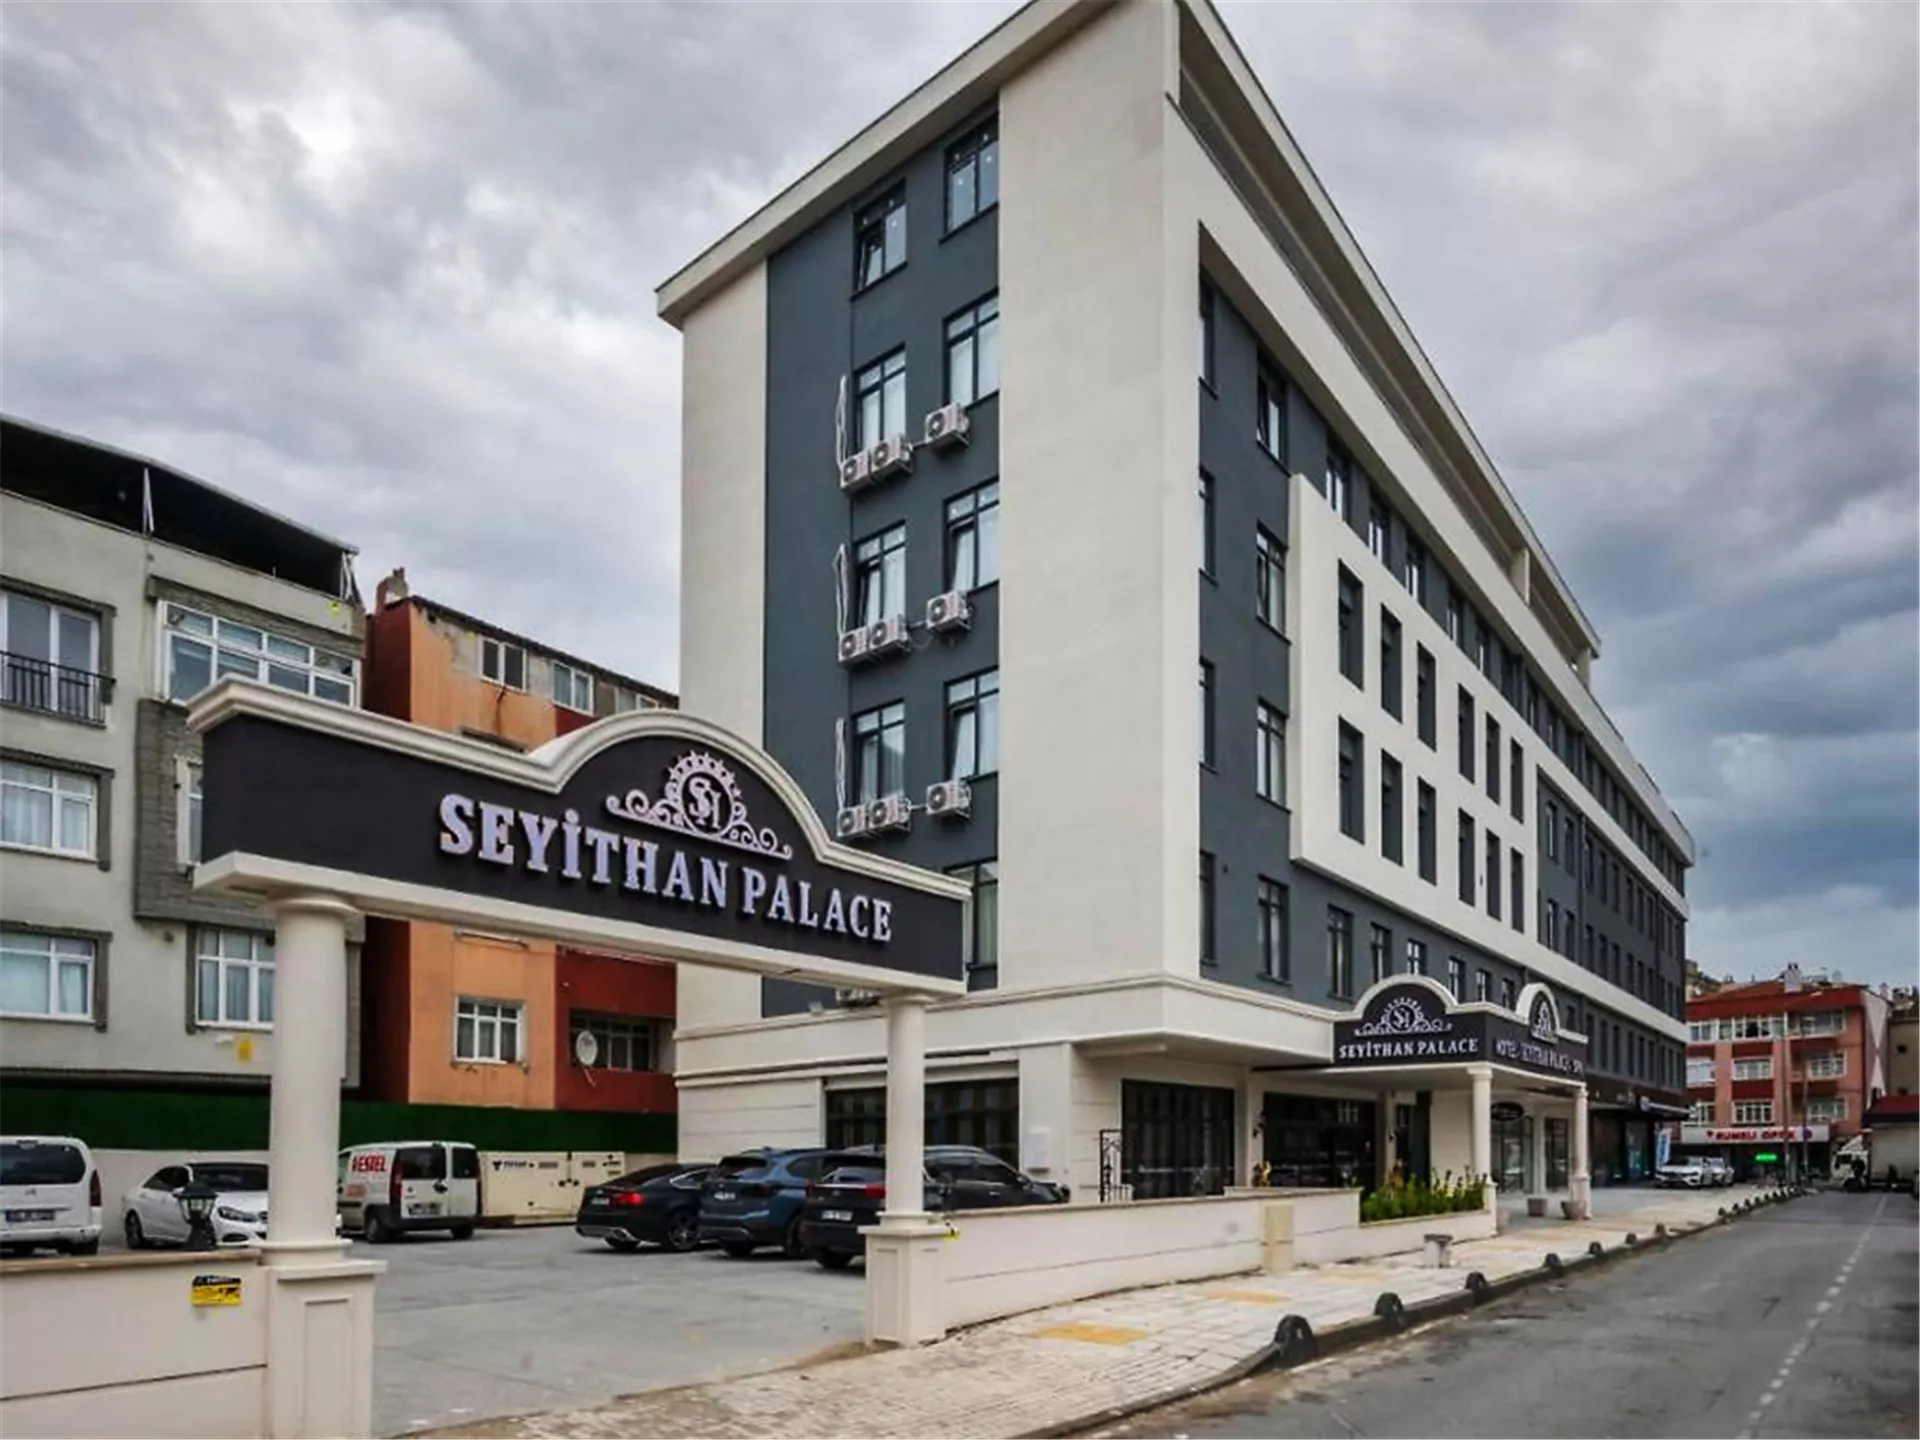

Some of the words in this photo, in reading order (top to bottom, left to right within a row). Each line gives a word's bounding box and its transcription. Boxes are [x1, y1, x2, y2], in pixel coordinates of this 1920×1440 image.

[439, 793, 728, 909] SEYİTHAN
[741, 867, 893, 942] PALACE
[1339, 1041, 1414, 1059] SEYİTHAN
[1417, 1037, 1479, 1055] PALACE
